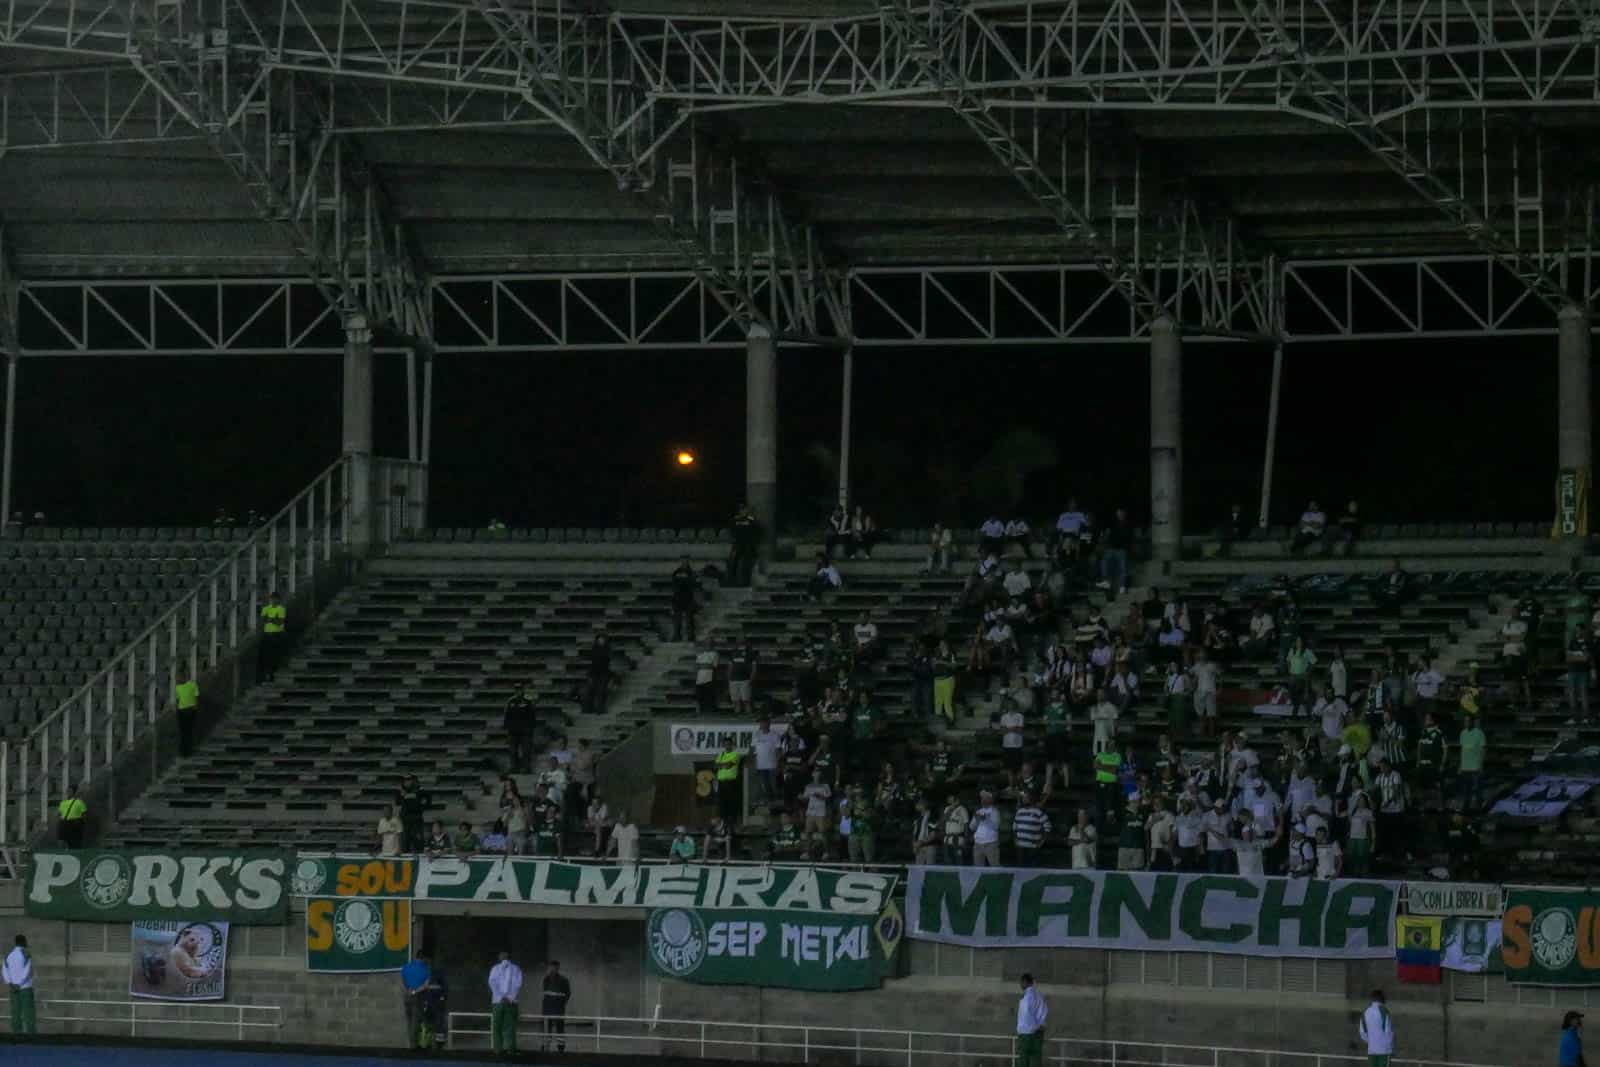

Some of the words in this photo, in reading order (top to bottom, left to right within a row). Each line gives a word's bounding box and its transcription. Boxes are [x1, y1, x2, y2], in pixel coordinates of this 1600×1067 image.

[336, 861, 411, 896] SOU
[414, 857, 885, 912] PALMEIRAS
[919, 872, 1394, 948] MANCHA
[708, 921, 767, 957] SEP
[781, 922, 870, 969] METAL
